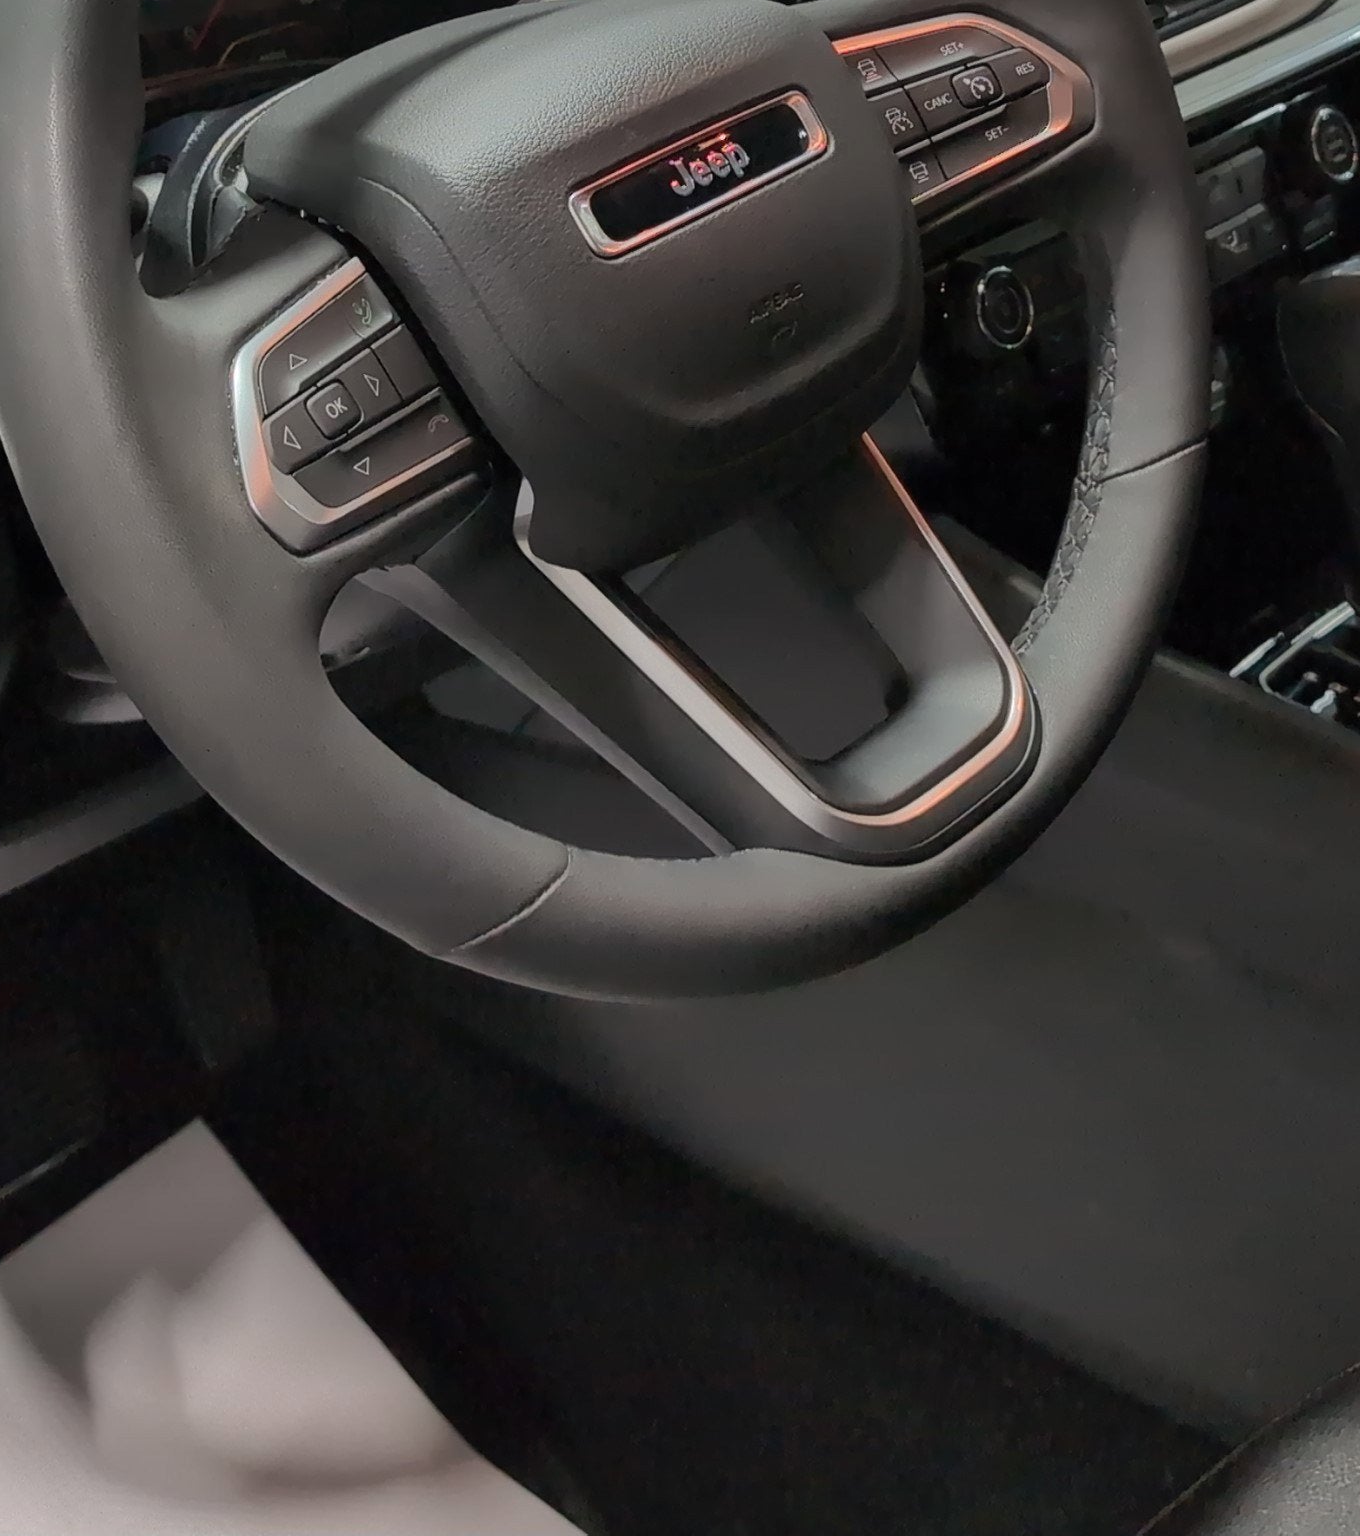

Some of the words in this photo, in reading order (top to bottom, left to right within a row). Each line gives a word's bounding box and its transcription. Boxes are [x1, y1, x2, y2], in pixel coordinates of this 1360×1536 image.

[940, 41, 965, 57] SET+
[1015, 61, 1036, 77] RES
[924, 92, 953, 112] CANC
[668, 142, 750, 197] Jeep
[325, 397, 348, 419] OK
